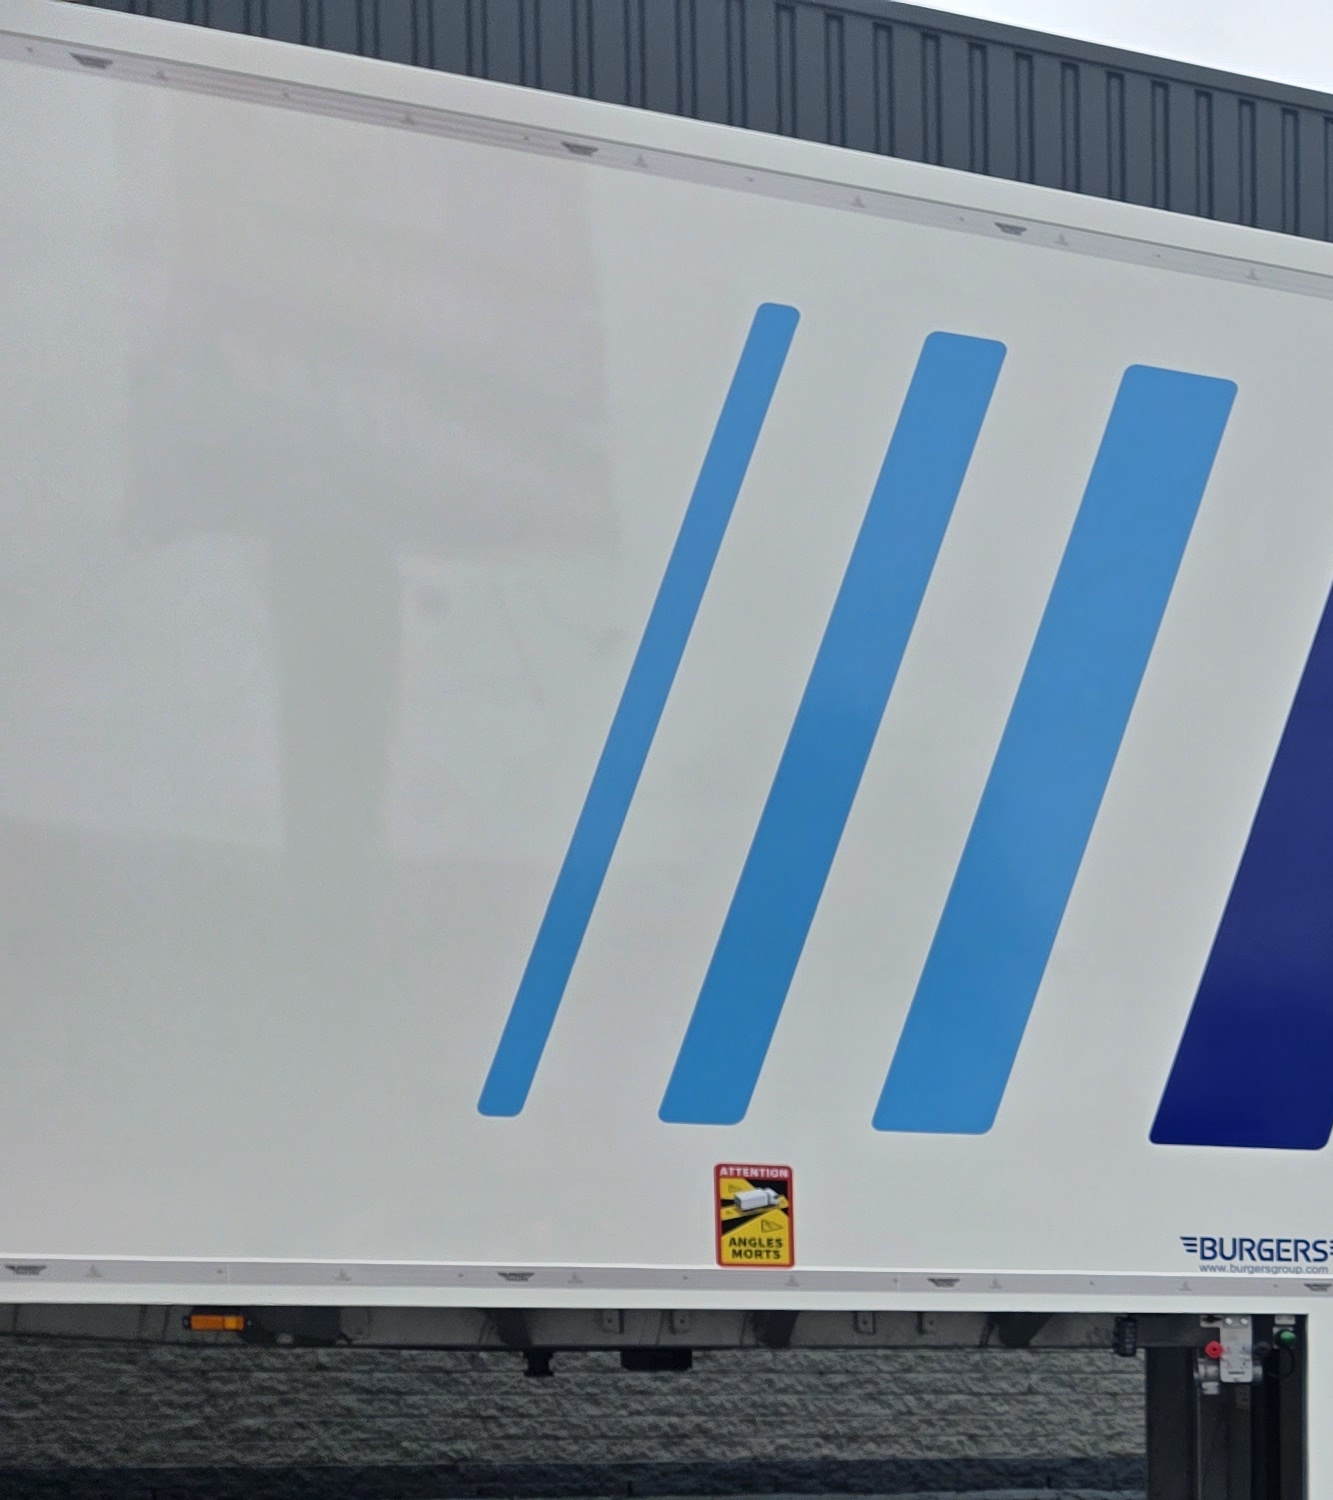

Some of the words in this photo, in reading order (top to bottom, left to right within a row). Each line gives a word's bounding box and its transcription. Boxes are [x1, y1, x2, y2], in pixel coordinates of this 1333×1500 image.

[719, 1166, 789, 1178] ATTENTION
[728, 1237, 783, 1248] ANGLES
[731, 1249, 781, 1260] MORTS
[1200, 1237, 1328, 1262] BURGERS
[1199, 1263, 1328, 1275] www.burgersgroup.com
